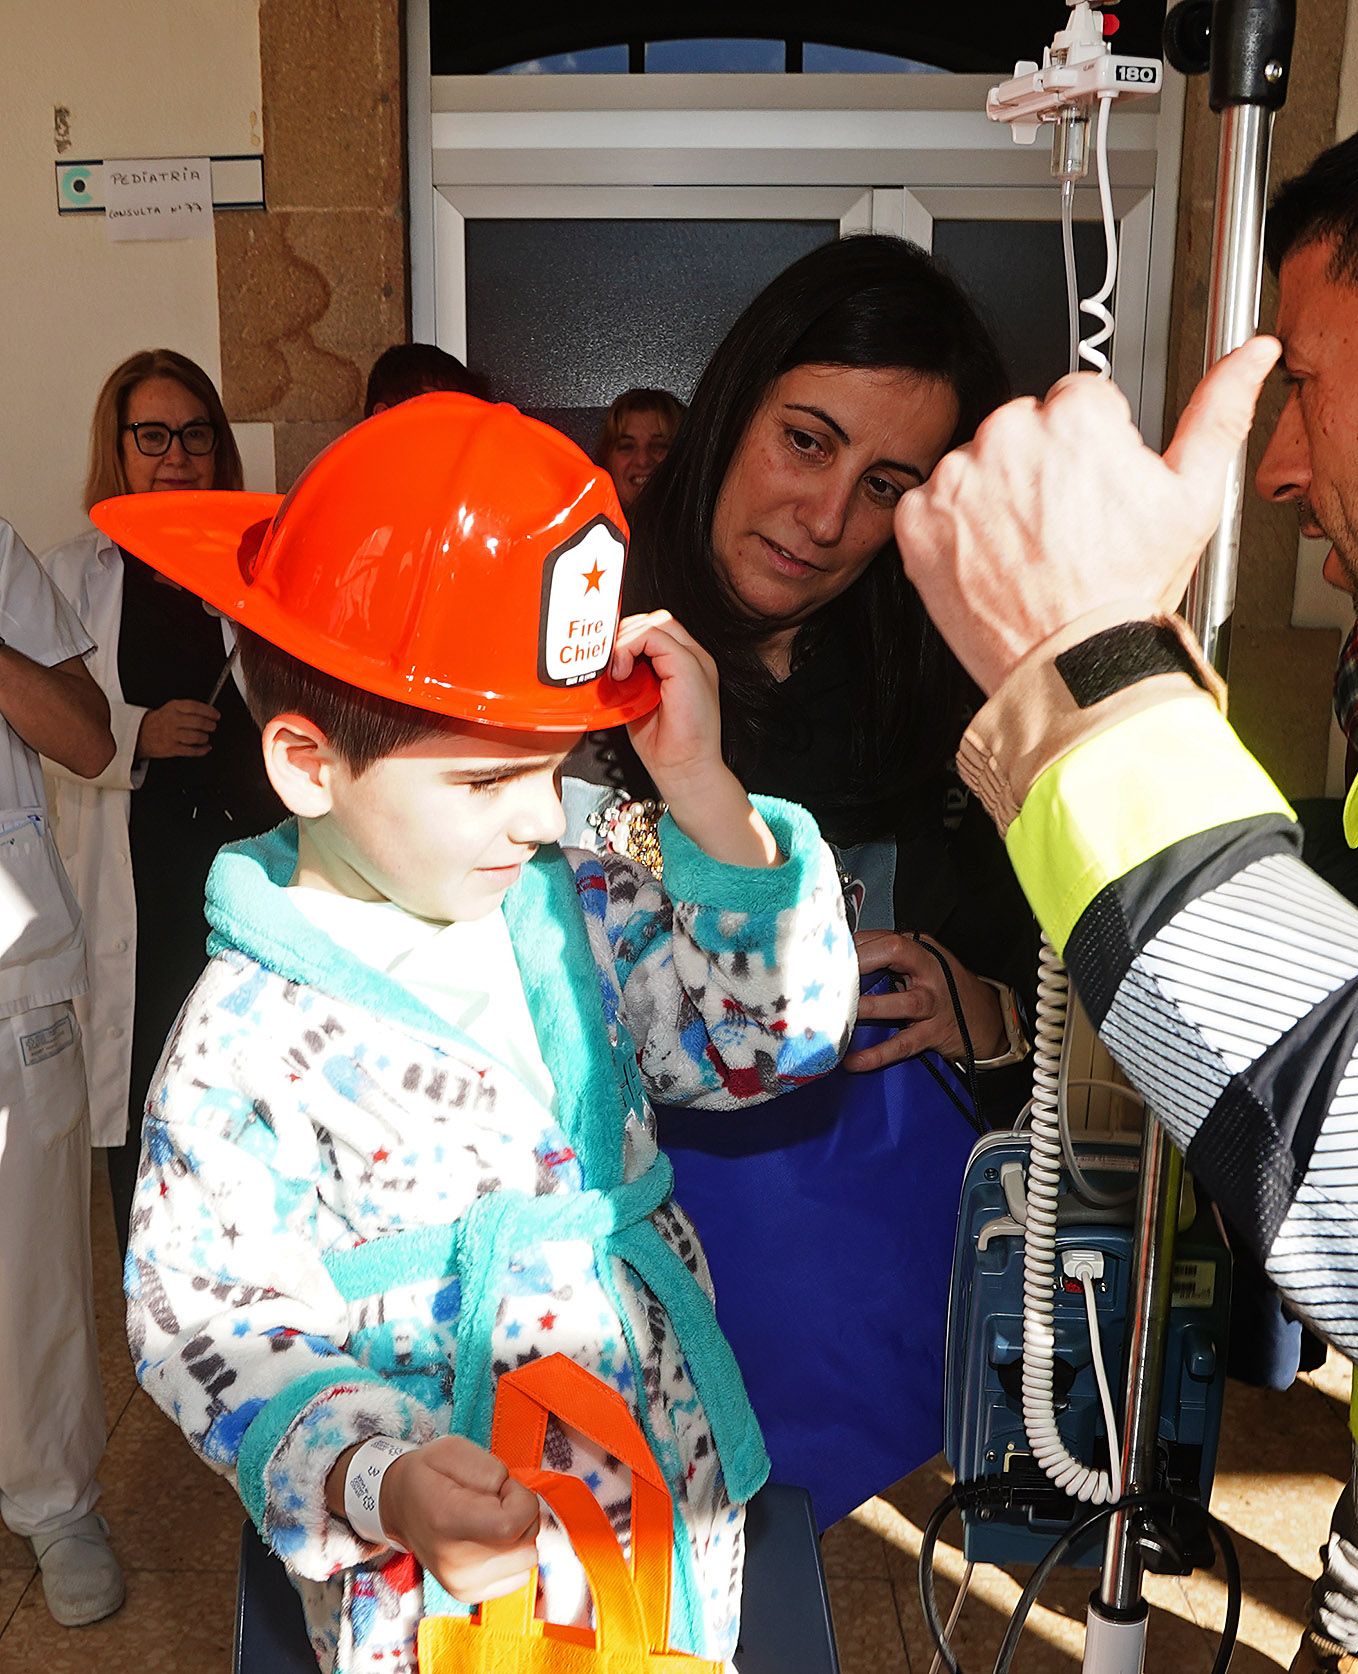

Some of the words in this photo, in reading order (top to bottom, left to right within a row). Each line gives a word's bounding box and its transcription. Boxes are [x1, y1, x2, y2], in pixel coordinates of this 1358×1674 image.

[1118, 66, 1154, 82] 180
[108, 205, 161, 219] CONSULTA
[568, 619, 604, 639] Fire
[560, 636, 607, 664] Chief
